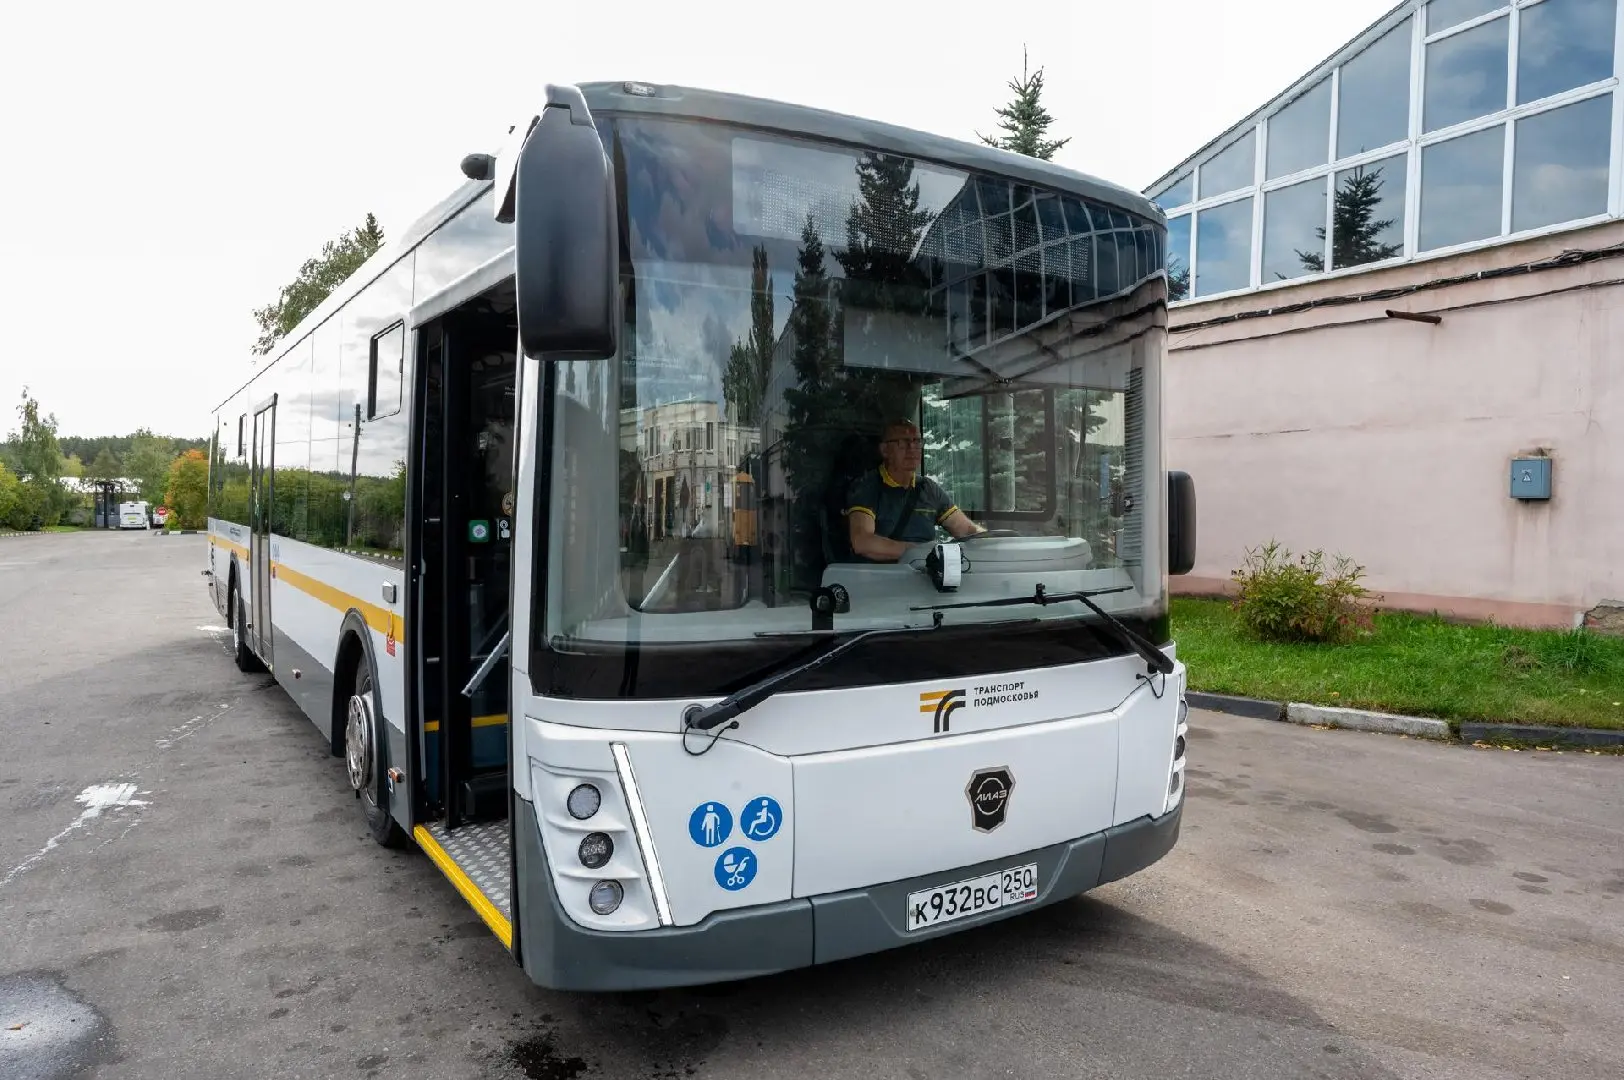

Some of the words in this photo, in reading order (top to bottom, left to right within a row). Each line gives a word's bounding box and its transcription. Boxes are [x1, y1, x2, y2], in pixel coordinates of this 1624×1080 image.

[974, 682, 1025, 695] ТРАНСПОРТ
[974, 690, 1039, 707] ПОДМОСКОВЬЯ
[1003, 868, 1032, 894] 250
[1009, 891, 1025, 900] RUS
